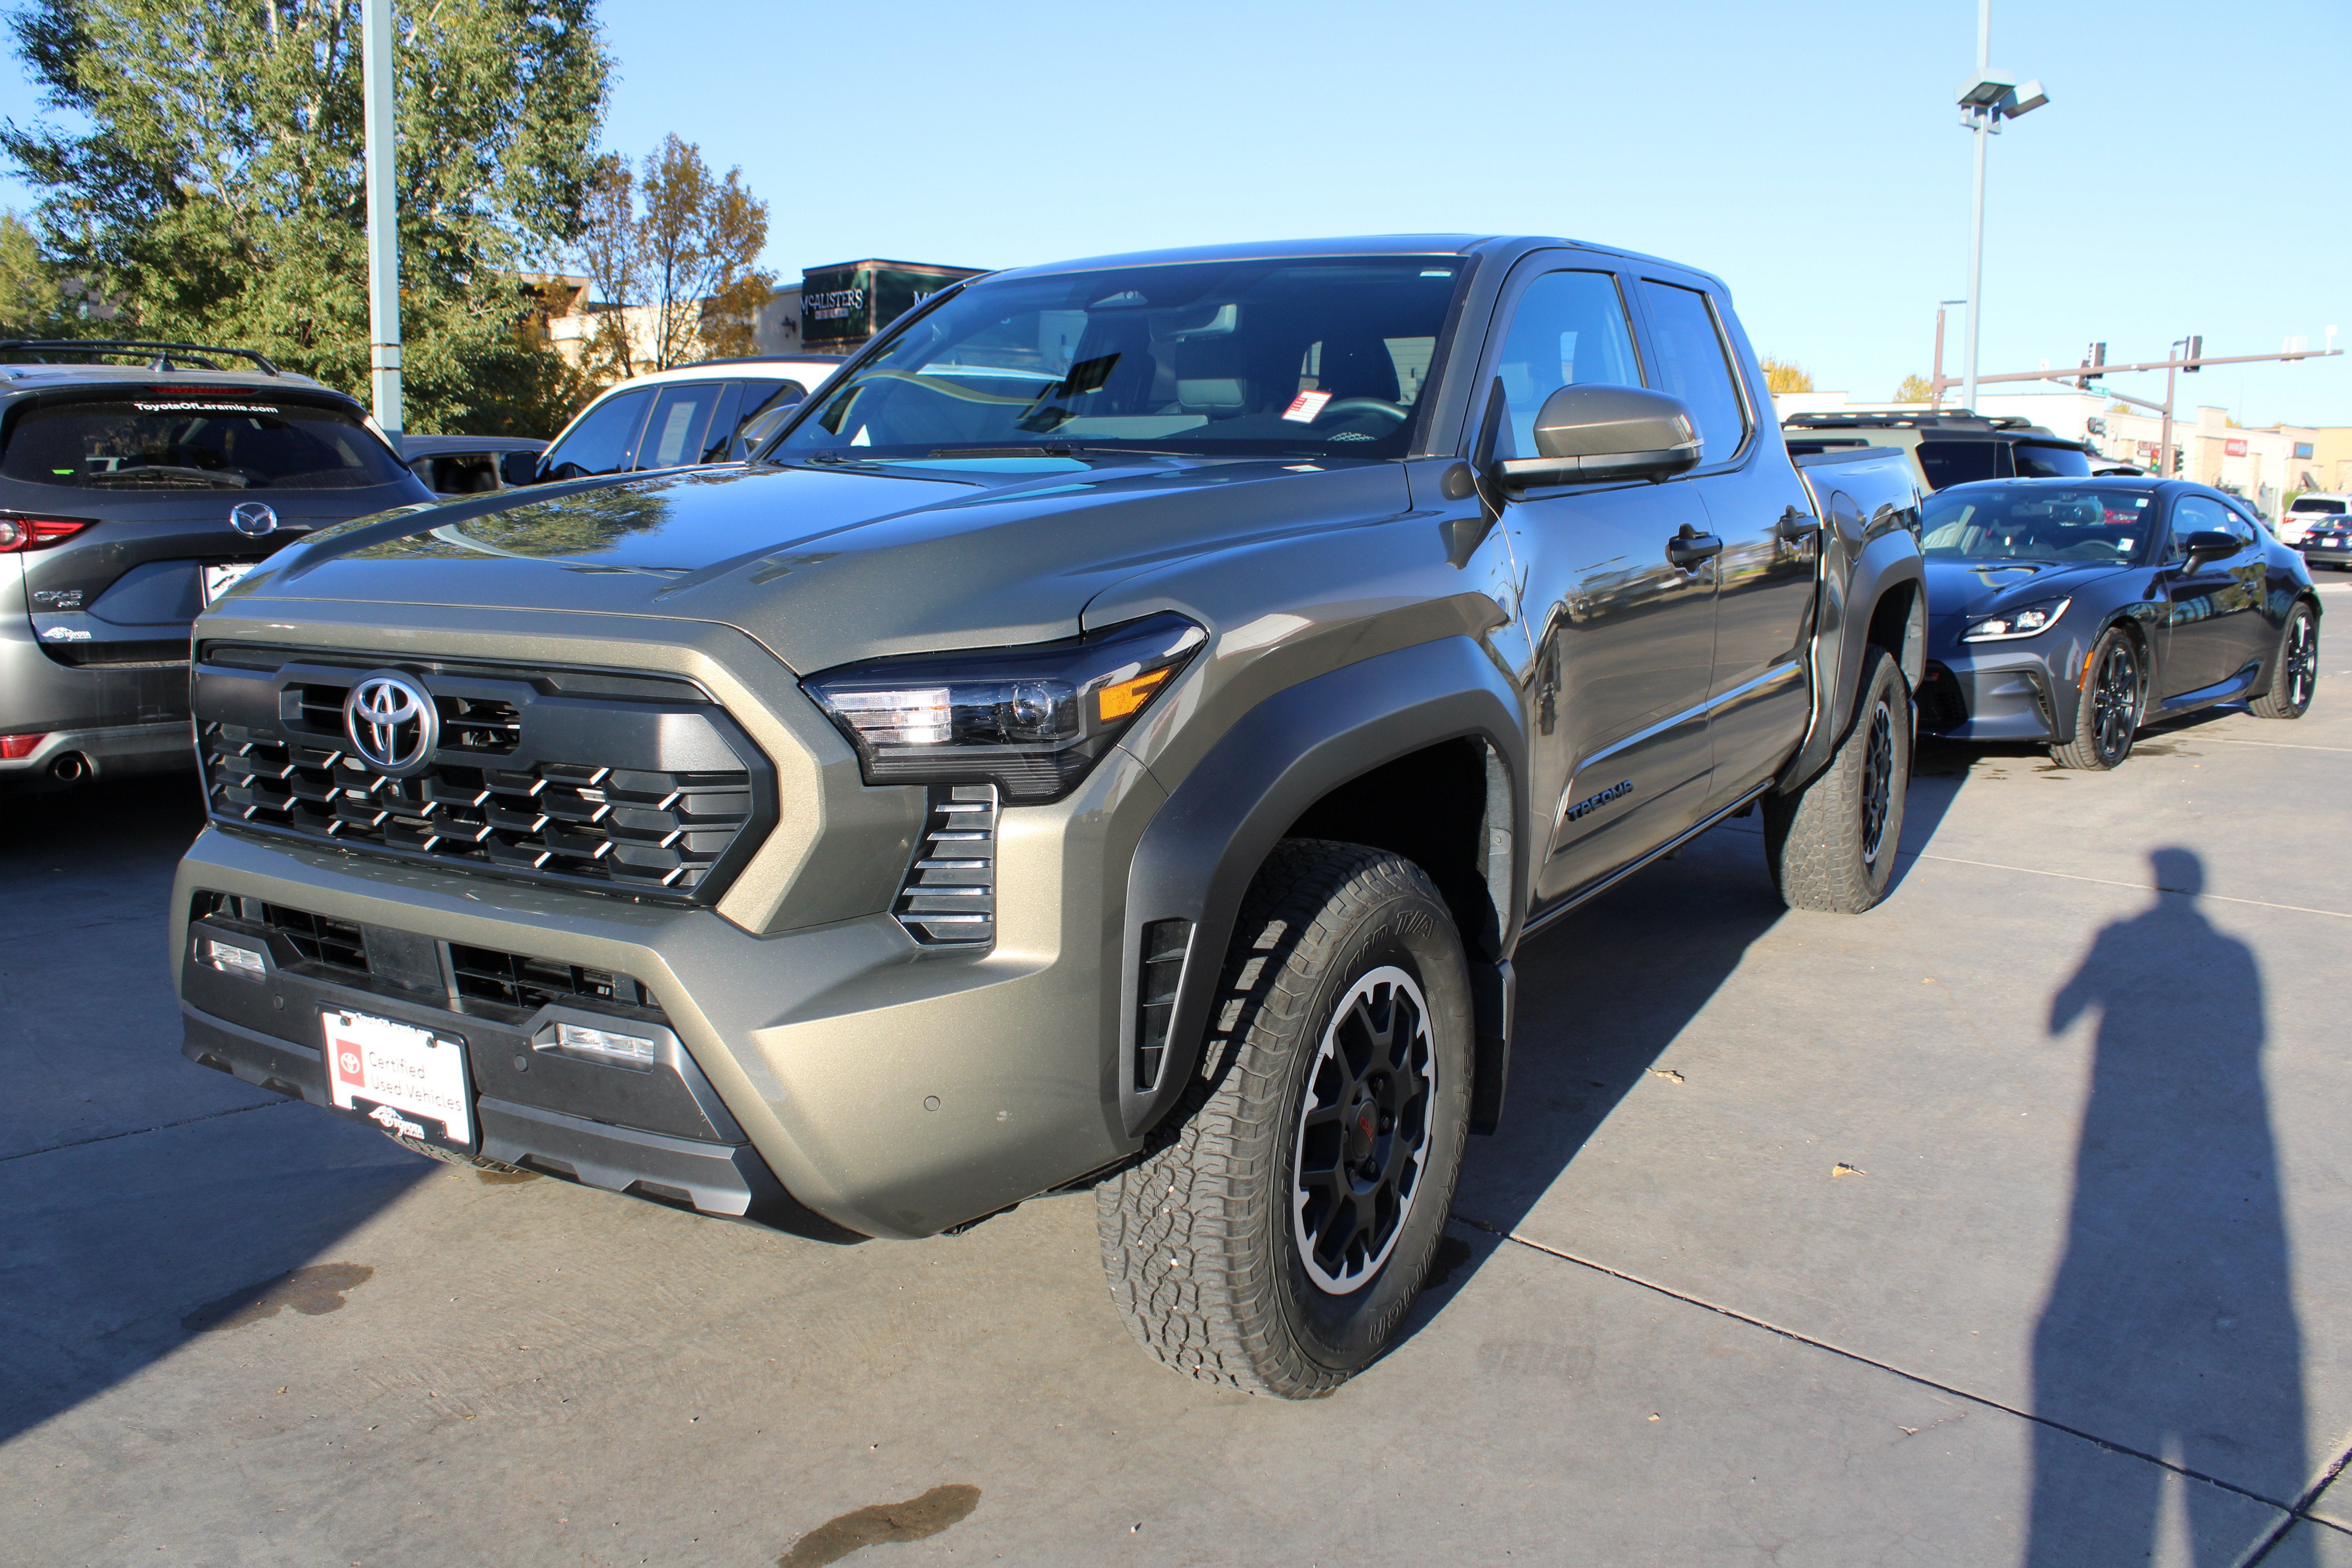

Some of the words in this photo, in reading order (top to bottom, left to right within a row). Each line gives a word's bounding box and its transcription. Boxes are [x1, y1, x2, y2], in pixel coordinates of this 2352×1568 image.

[820, 309, 841, 318] DELI
[134, 402, 278, 413] ToyotaOfLaramie.com
[33, 590, 83, 602] CX-5
[1566, 780, 1634, 822] TACOMA
[369, 1051, 425, 1079] Certified
[371, 1074, 402, 1096] Used
[406, 1083, 462, 1111] Vehicles
[393, 1117, 425, 1136] TOYOTA
